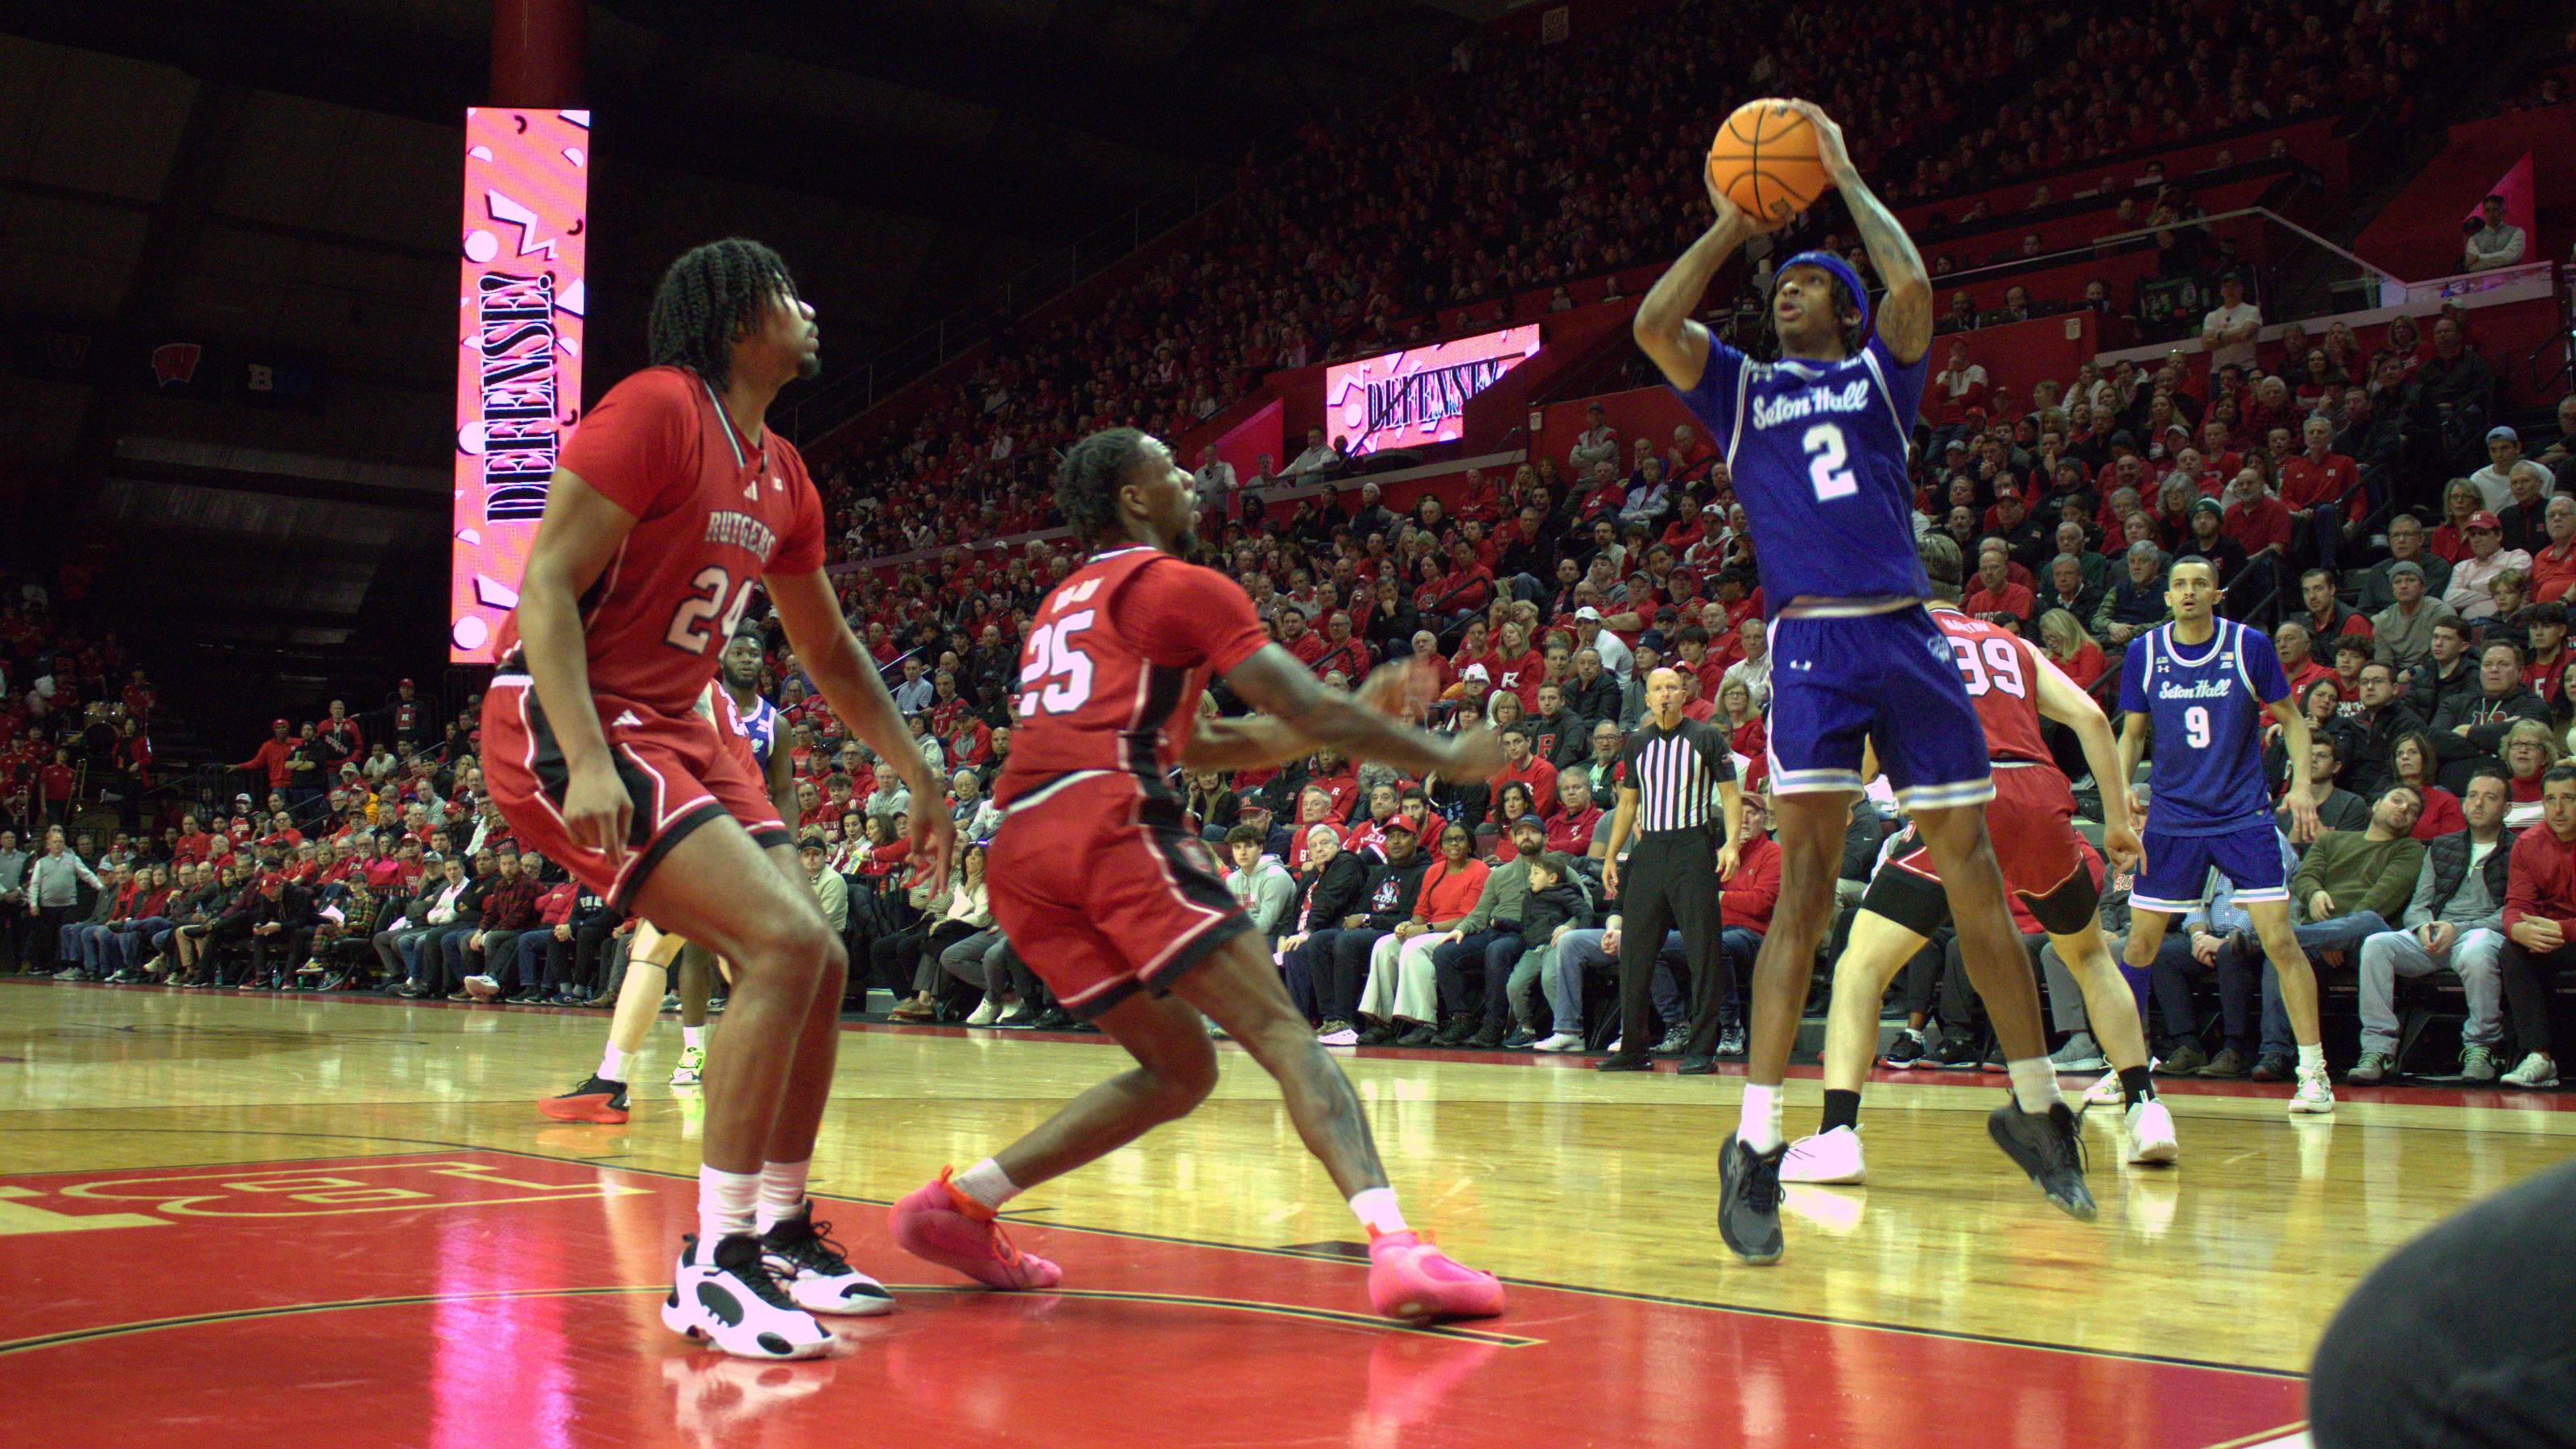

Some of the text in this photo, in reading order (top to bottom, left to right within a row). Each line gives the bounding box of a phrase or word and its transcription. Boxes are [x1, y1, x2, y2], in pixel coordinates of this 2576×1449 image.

[478, 272, 555, 525] DEFENSE!
[1753, 378, 1869, 431] Seton Hall
[1802, 421, 1859, 504] 2
[705, 510, 777, 564] RUTGERS
[663, 565, 753, 660] 24
[1018, 608, 1096, 717] 25
[1502, 671, 1521, 689] R
[2159, 678, 2231, 699] Seton Hall
[2185, 705, 2211, 749] 9
